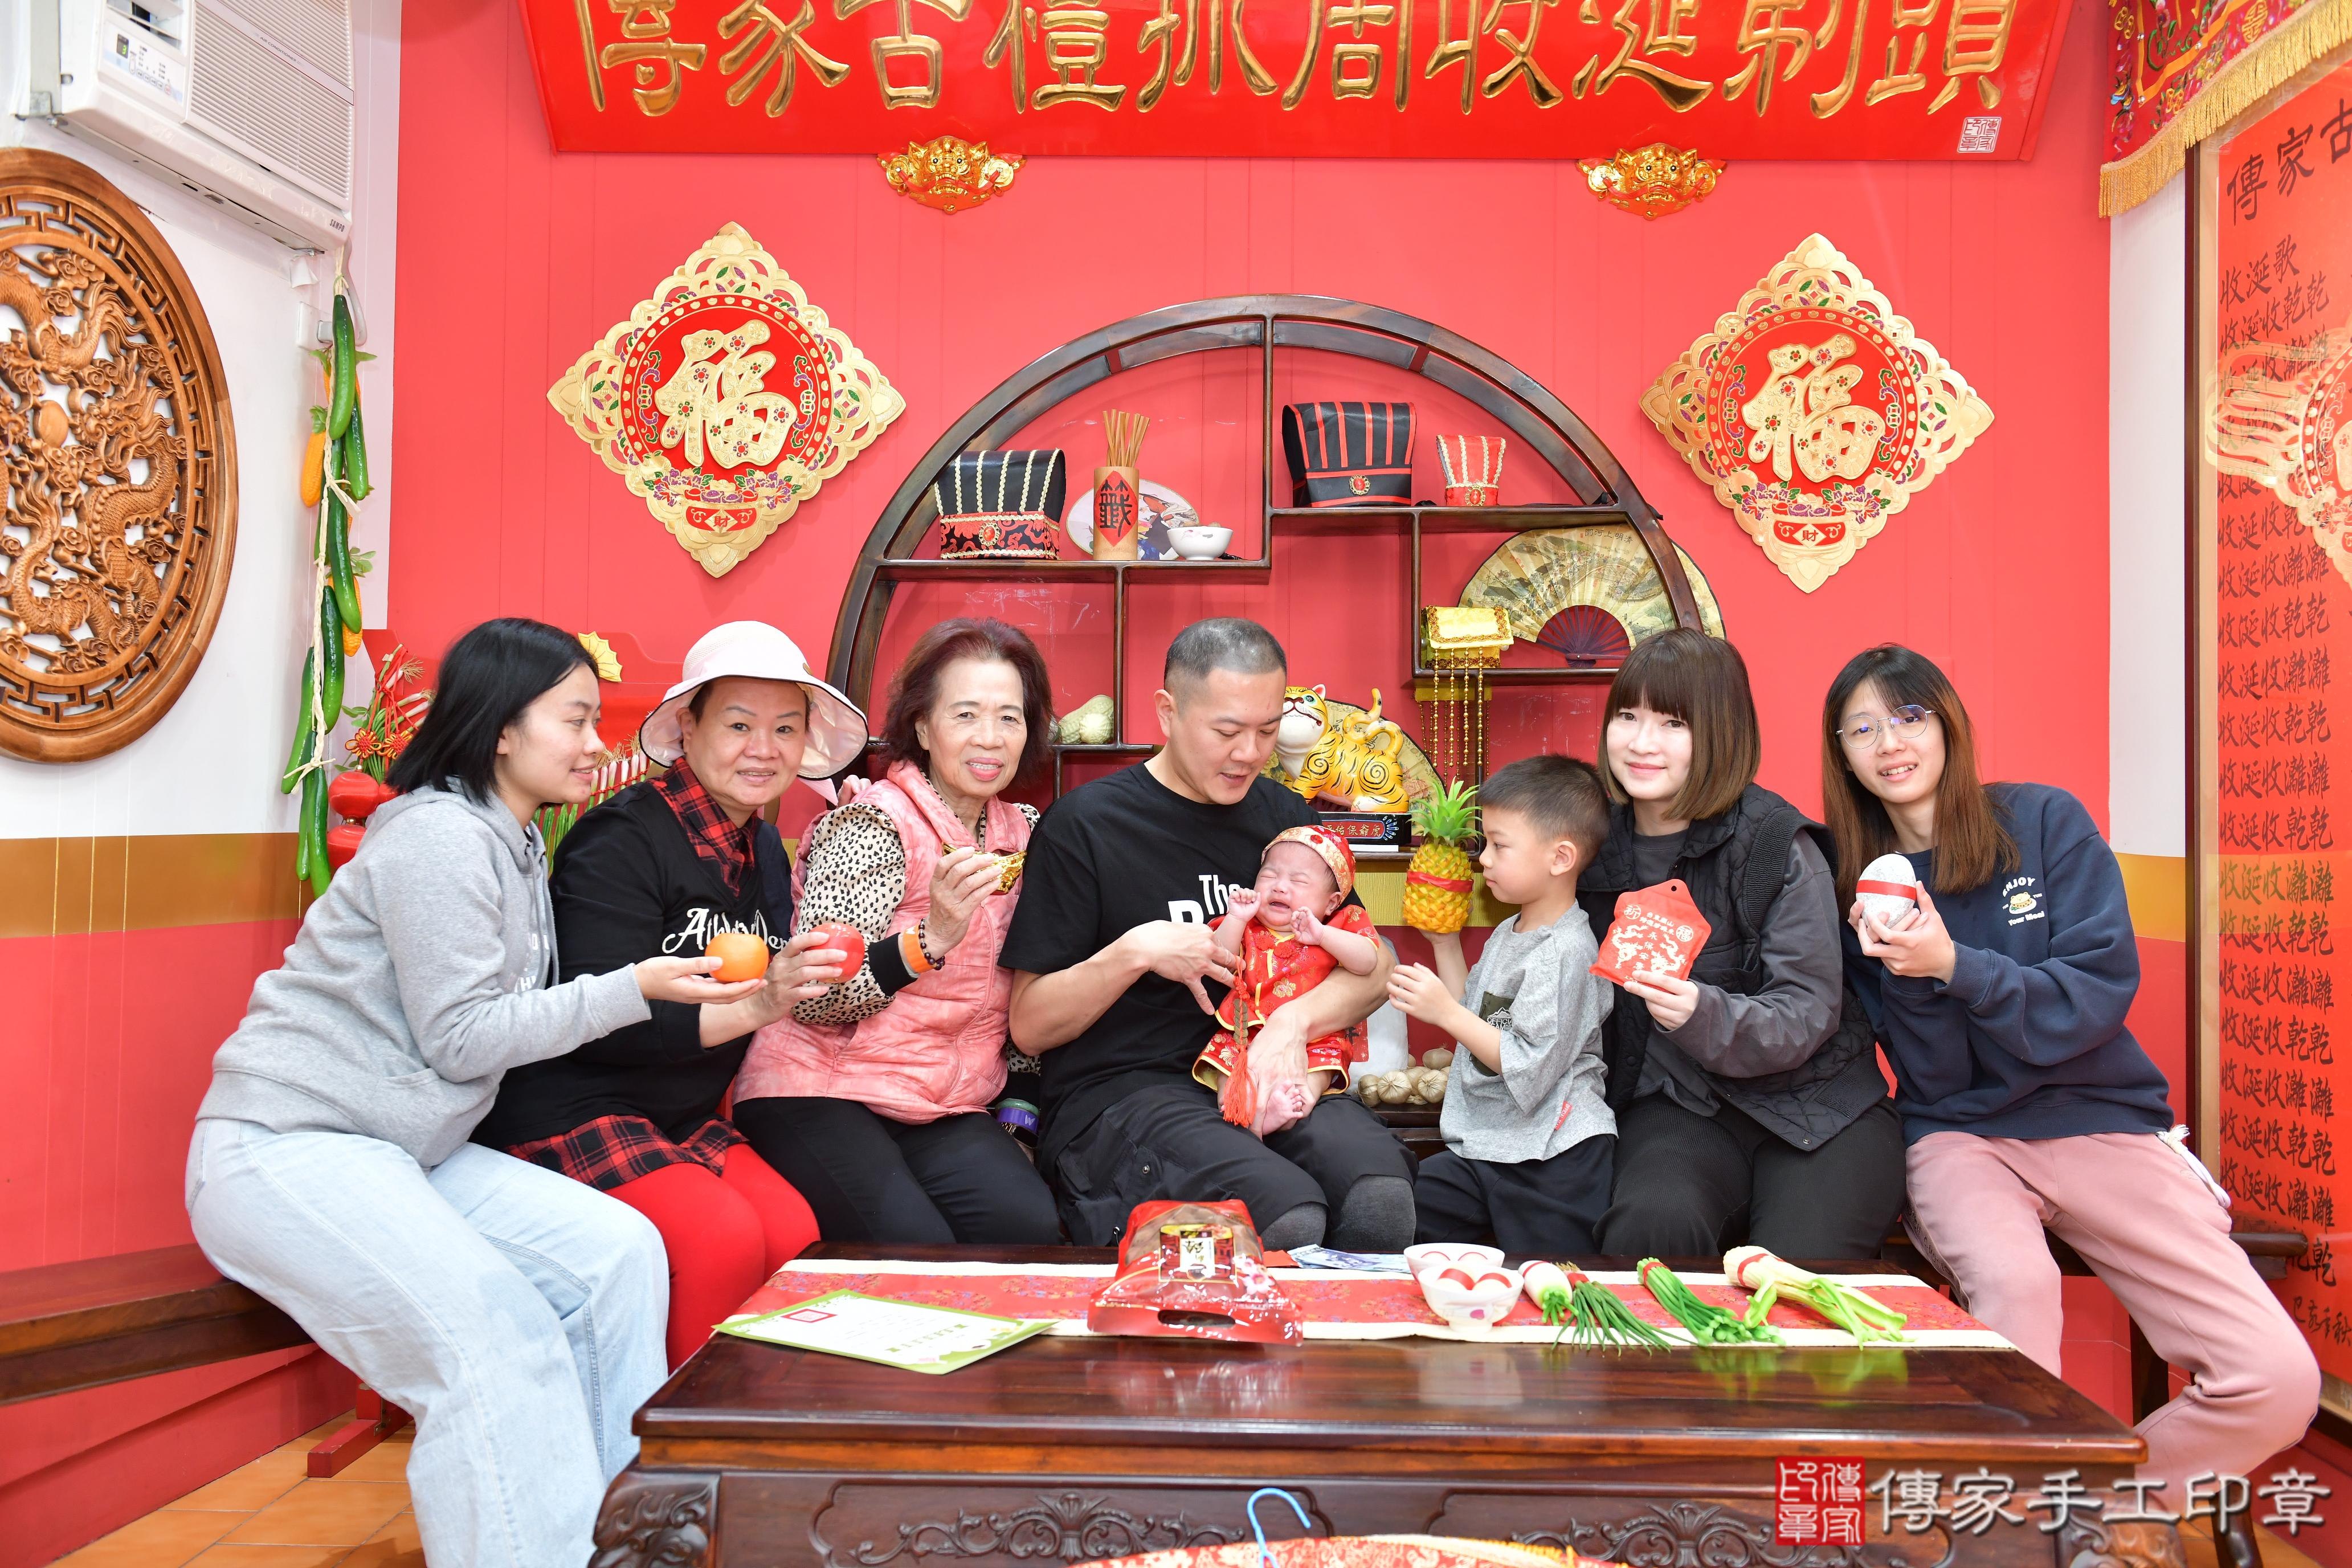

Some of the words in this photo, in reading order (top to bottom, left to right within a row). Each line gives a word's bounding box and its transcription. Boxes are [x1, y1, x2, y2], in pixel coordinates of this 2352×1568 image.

[268, 42, 297, 62] CONDITIONER
[329, 219, 345, 232] SAMPO
[655, 319, 798, 469] 福
[1741, 333, 1885, 483] 福
[713, 516, 731, 528] 財
[1801, 529, 1818, 542] 財
[2002, 876, 2036, 897] ENJOY
[2008, 916, 2025, 926] Your
[2024, 910, 2045, 921] Meal
